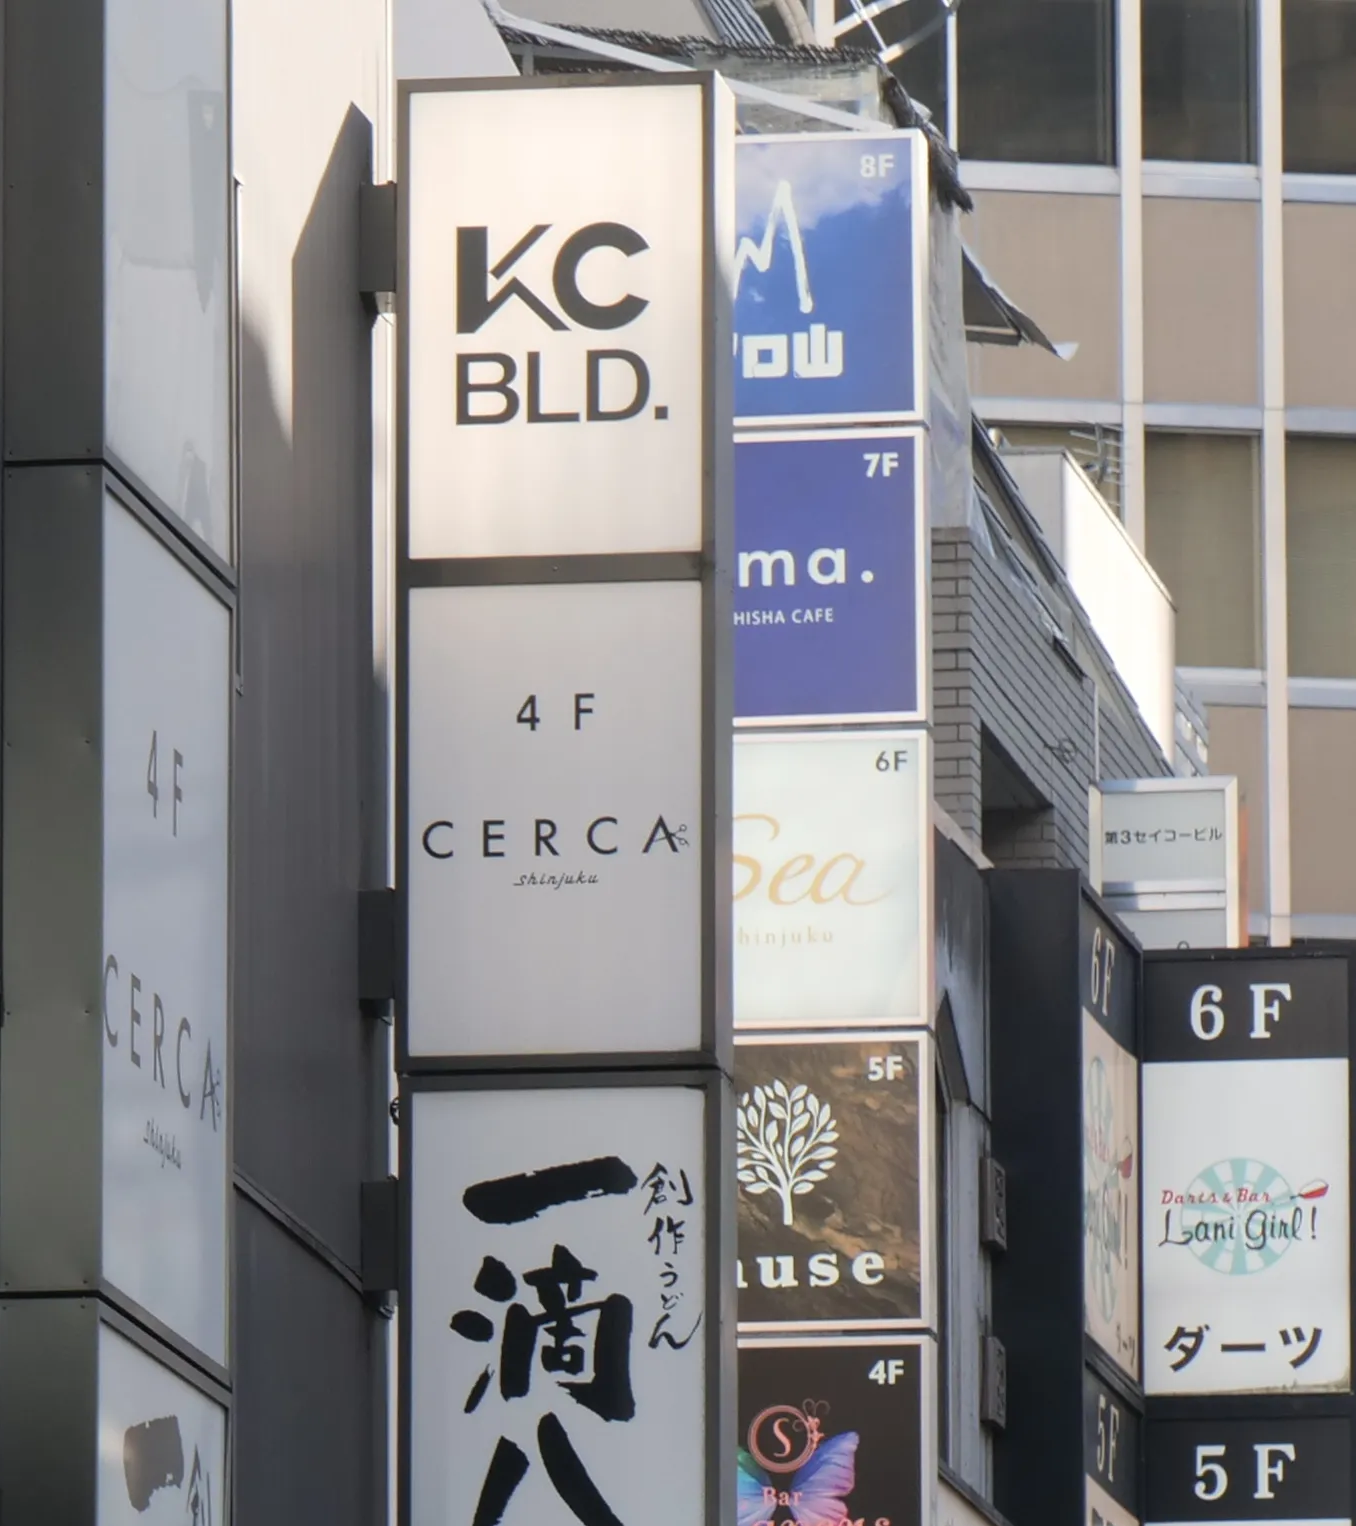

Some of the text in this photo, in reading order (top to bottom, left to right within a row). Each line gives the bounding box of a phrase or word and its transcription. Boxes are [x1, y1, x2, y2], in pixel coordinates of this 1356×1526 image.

[860, 154, 894, 178] 8F
[456, 222, 650, 333] KC
[733, 323, 843, 378] ow
[456, 348, 669, 426] BLD.
[863, 452, 899, 478] 7F
[791, 608, 834, 624] CAFE
[516, 694, 596, 731] 4F
[876, 750, 908, 772] 6F
[147, 730, 184, 837] 4F
[423, 816, 688, 860] CERCA
[1104, 827, 1223, 846] 第3セイコービル
[1090, 927, 1116, 1017] 6F
[1190, 984, 1292, 1041] 6F
[102, 953, 220, 1132] CERCA
[868, 1056, 903, 1081] 5F
[1161, 1187, 1271, 1206] Darts & Bar
[1158, 1208, 1235, 1246] Lani
[640, 1163, 702, 1352] 創作うどん
[1164, 1325, 1323, 1373] ダーツ
[868, 1359, 904, 1384] 4F
[1096, 1394, 1120, 1482] 5F
[1194, 1443, 1297, 1501] 5F
[762, 1486, 802, 1506] Bar
